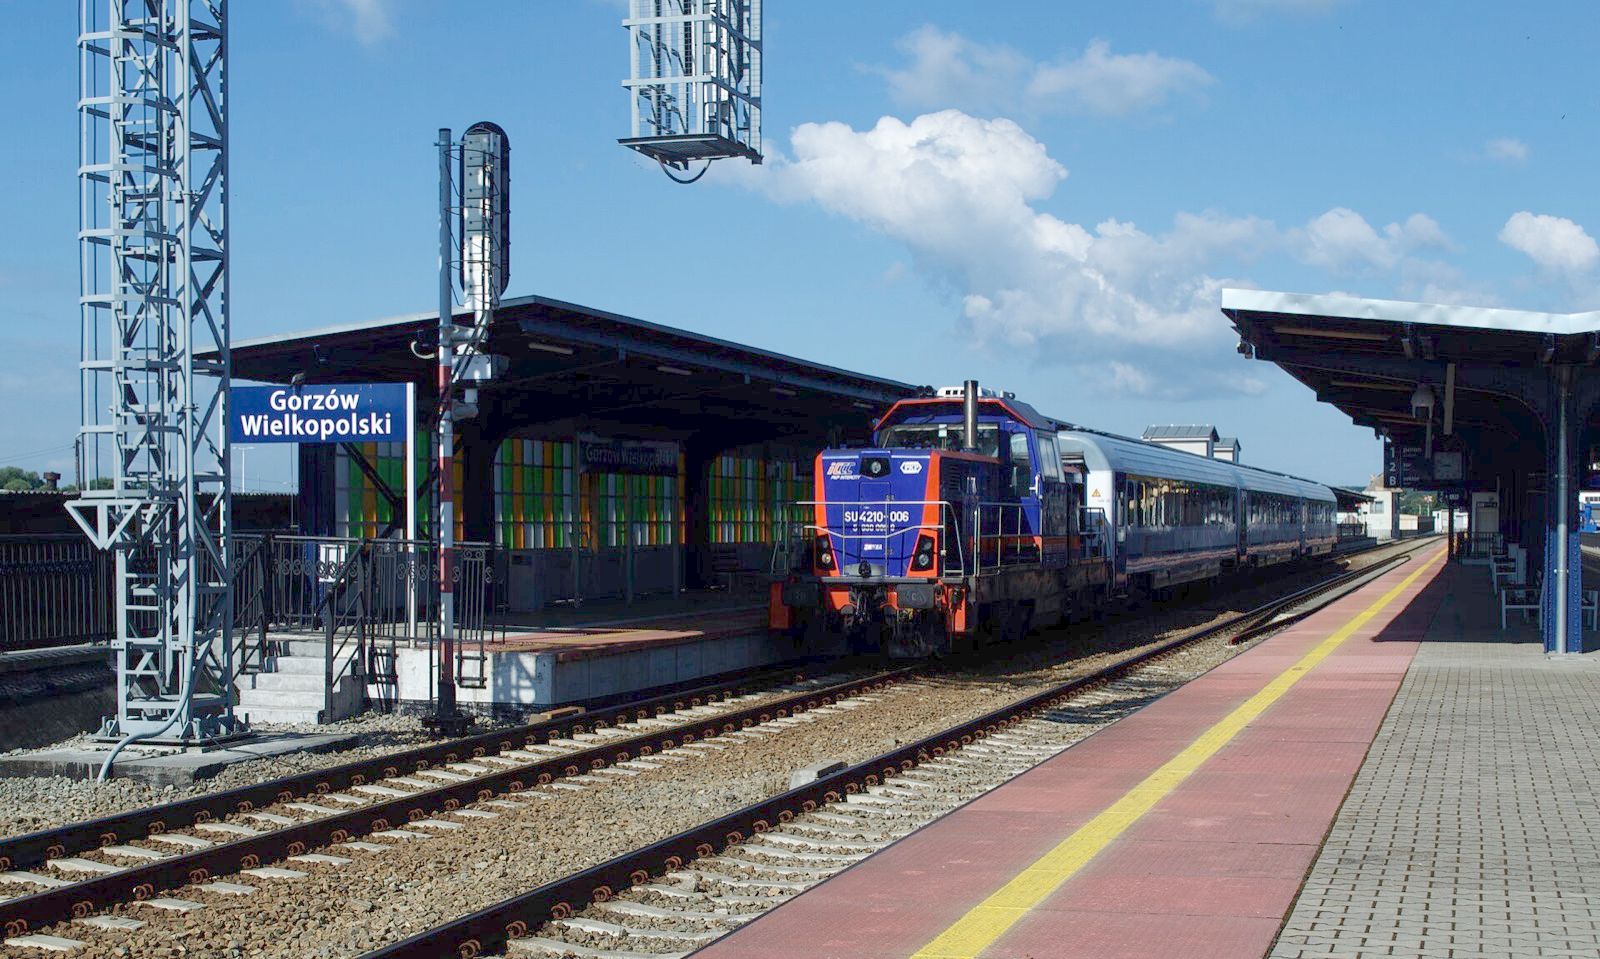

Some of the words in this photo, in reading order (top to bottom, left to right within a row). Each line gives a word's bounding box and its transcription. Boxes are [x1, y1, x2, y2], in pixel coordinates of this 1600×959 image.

[270, 389, 359, 411] Gorzów
[240, 412, 392, 440] Wielkopolski
[1389, 447, 1395, 458] 1
[1389, 462, 1396, 472] 2
